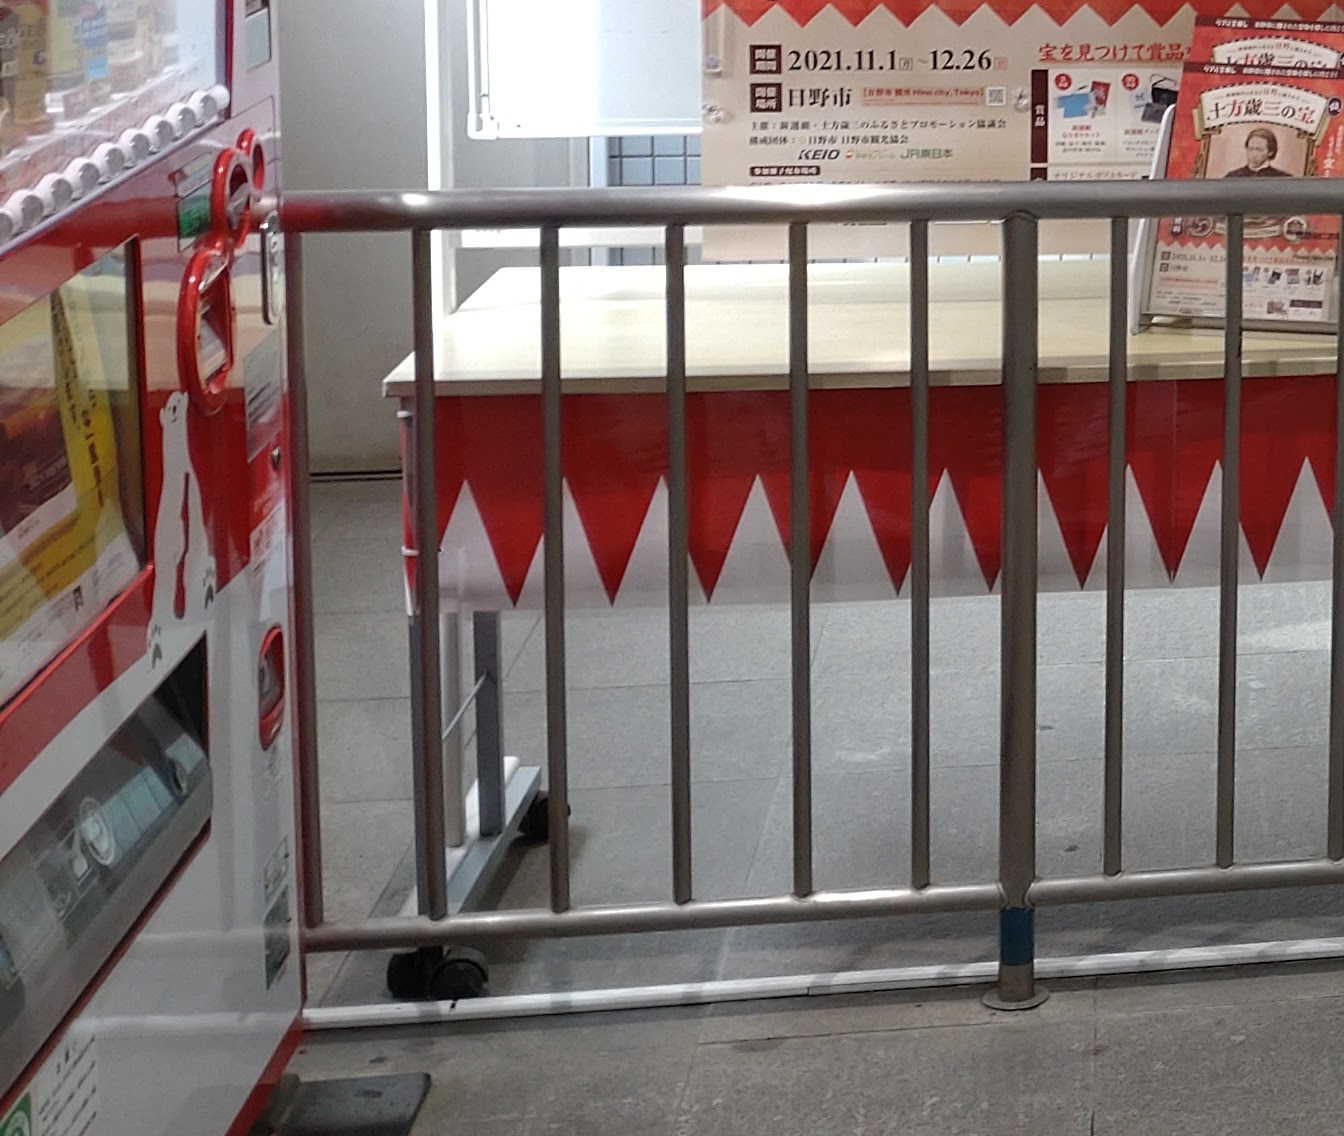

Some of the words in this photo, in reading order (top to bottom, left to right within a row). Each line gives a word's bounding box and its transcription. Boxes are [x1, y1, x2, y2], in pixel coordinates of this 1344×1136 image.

[1038, 42, 1190, 62] 宝を見つけて賞品
[788, 87, 852, 108] 日野市
[1207, 98, 1316, 125] 土方歳三の宝
[798, 149, 841, 161] KEIO
[901, 148, 954, 160] JR東日本
